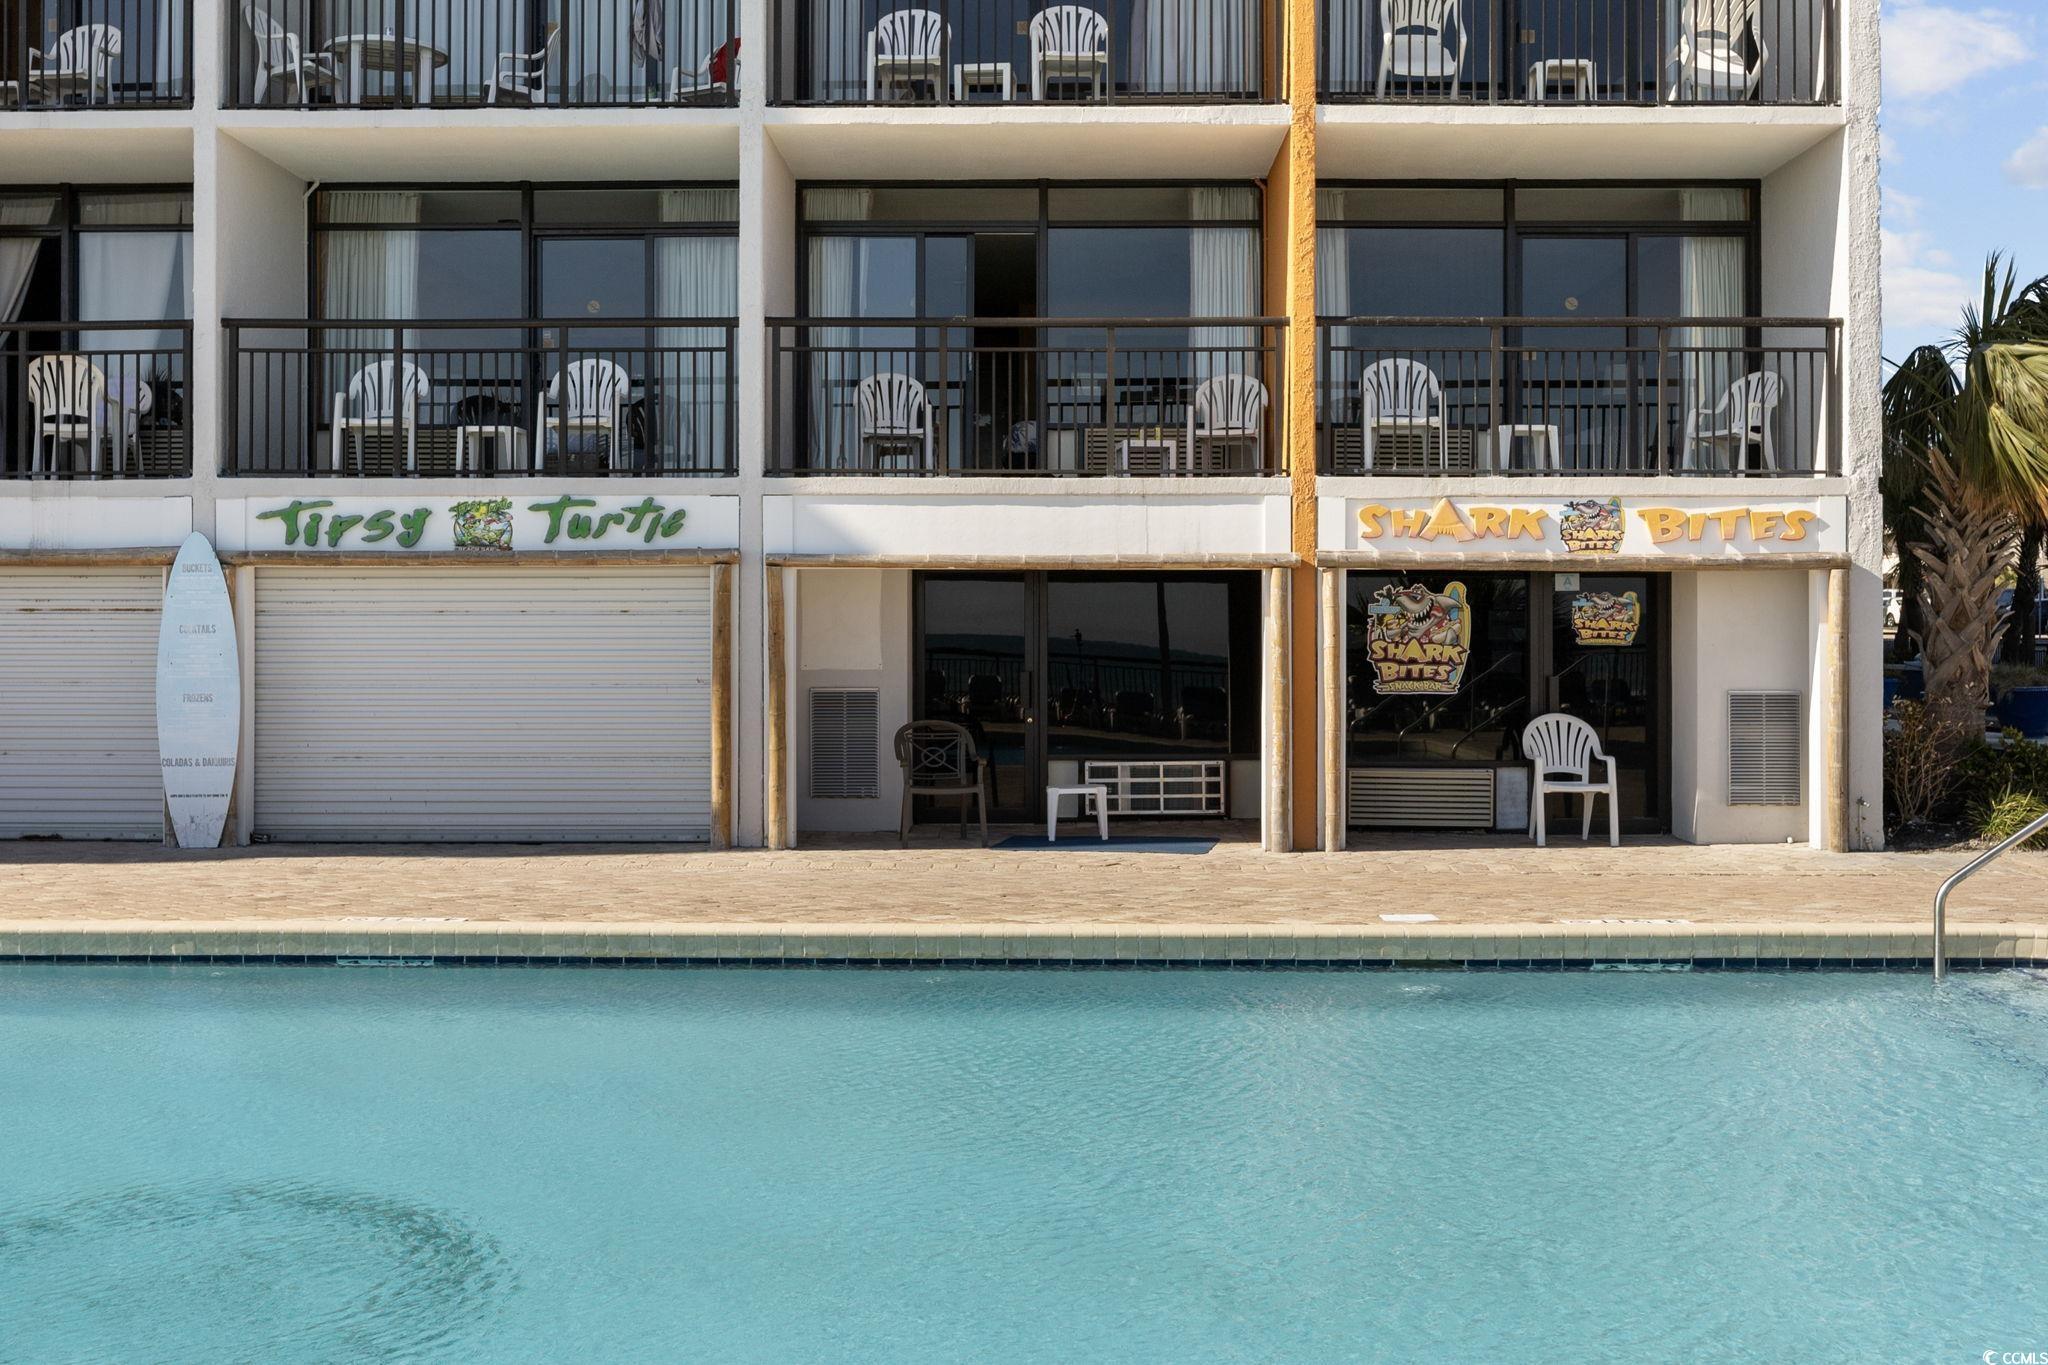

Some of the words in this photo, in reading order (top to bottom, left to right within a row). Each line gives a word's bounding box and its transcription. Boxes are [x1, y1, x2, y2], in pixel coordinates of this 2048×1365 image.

[256, 499, 432, 548] Tipsy
[527, 494, 687, 544] Turtle
[1357, 497, 1549, 543] SHARK
[1637, 506, 1817, 544] BITES
[1562, 527, 1624, 541] SHARK
[1566, 540, 1615, 551] BITES
[182, 563, 213, 573] BUCKETS
[1574, 618, 1637, 631] SHARK
[1578, 629, 1626, 640] BITES
[1371, 638, 1465, 664] SHARK
[1378, 662, 1453, 681] BITES
[182, 693, 214, 703] FROZENS
[161, 757, 194, 768] COLADAS
[194, 758, 201, 768] &
